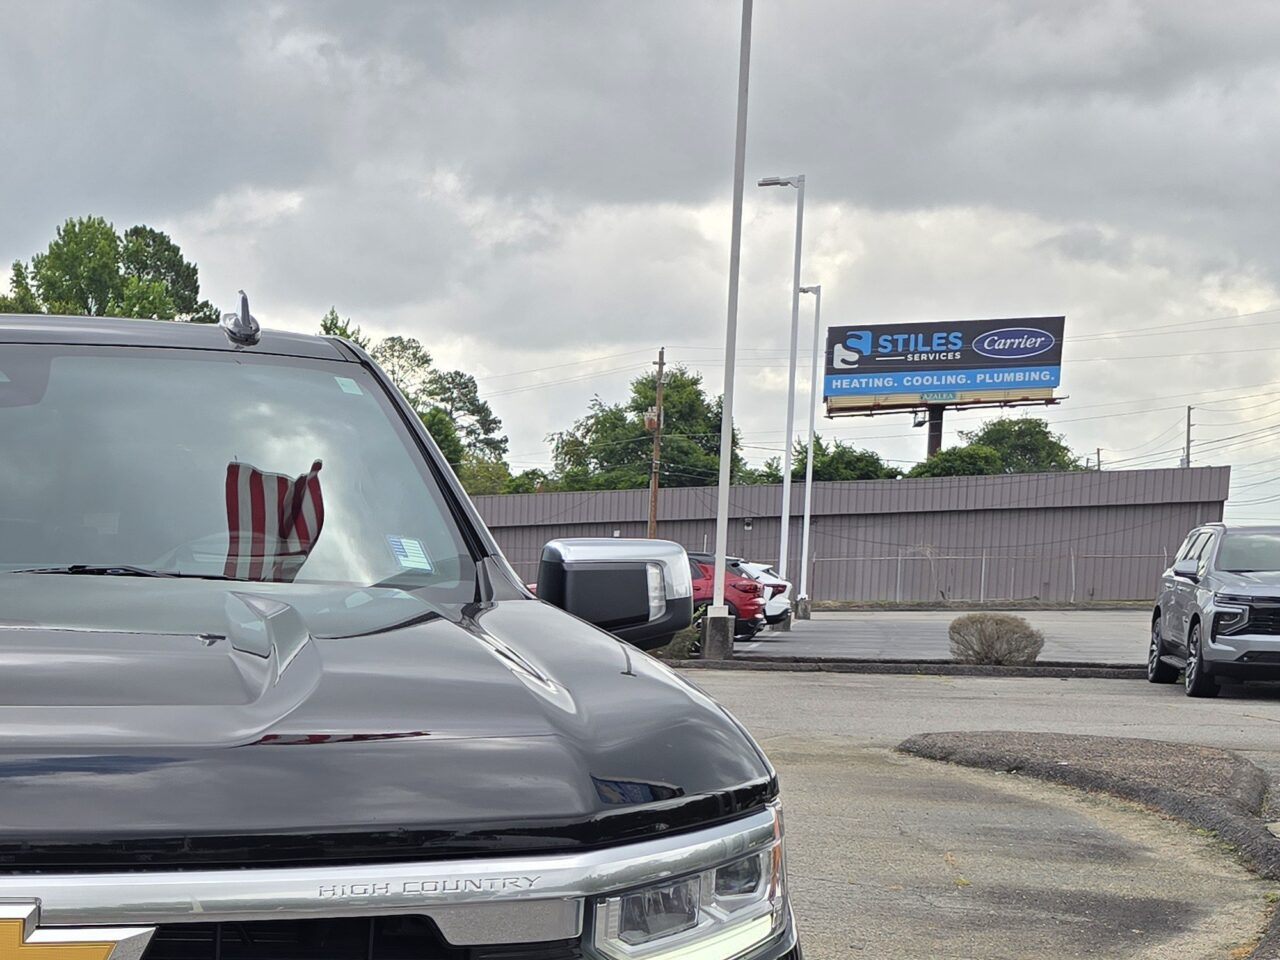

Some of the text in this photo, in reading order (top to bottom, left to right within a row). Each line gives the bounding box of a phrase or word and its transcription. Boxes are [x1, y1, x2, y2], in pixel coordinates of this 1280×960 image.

[877, 331, 963, 353] STILES
[983, 334, 1045, 351] Carrier
[906, 352, 961, 362] SERVICES
[832, 370, 1055, 389] HEATING. COOLING. PLUMBING.
[318, 875, 542, 898] HIGH COUNTRY
